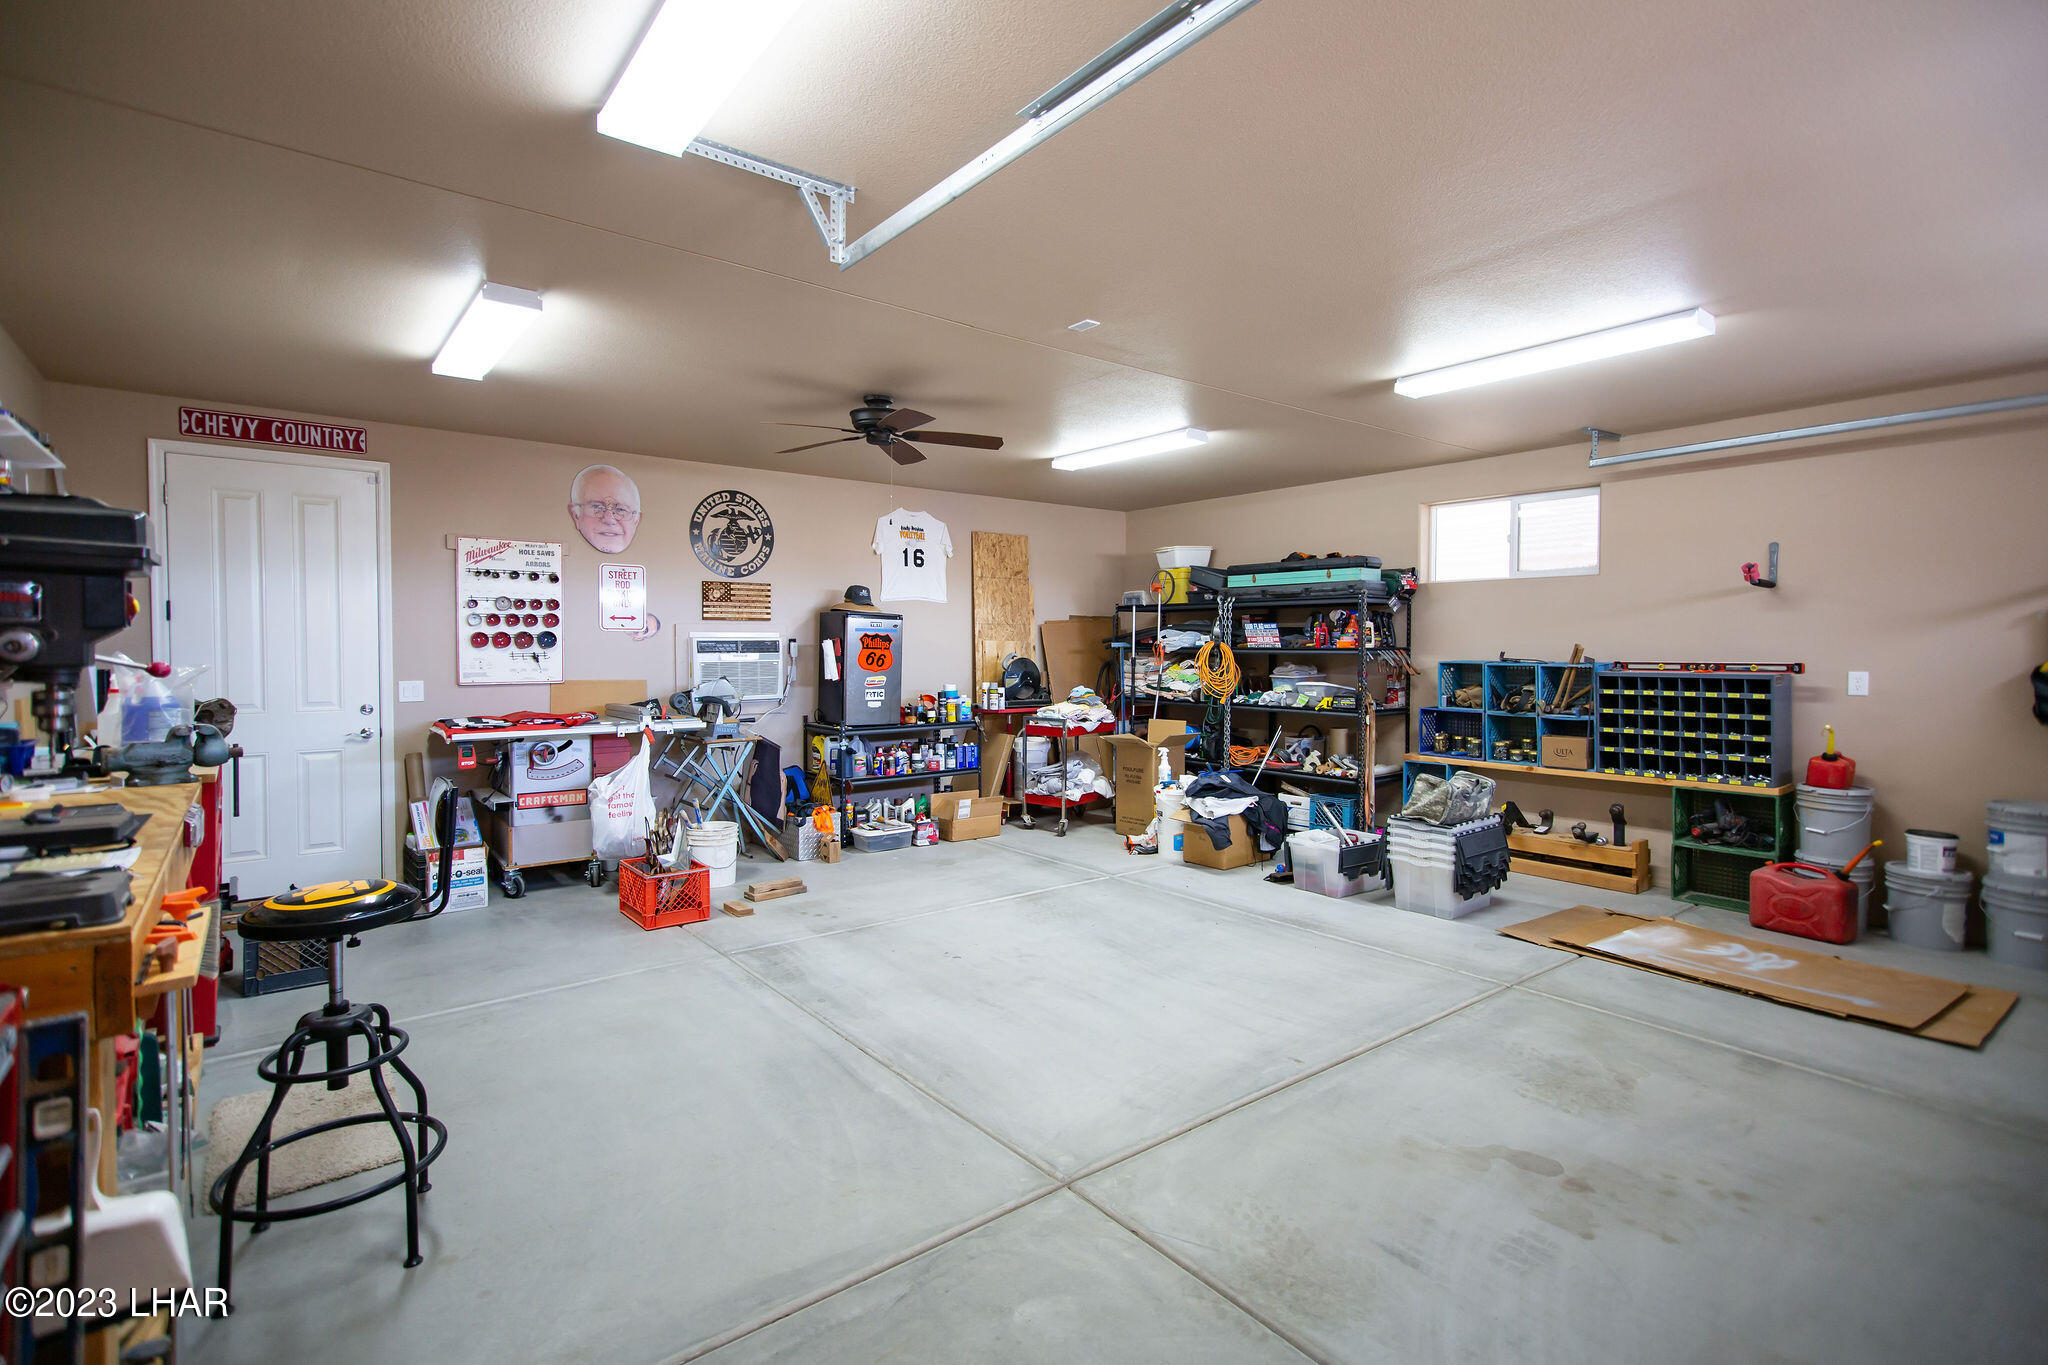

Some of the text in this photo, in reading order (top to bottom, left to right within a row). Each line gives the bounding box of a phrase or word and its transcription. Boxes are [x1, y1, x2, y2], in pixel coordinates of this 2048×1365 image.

[191, 412, 357, 450] CHEVY COUNTRY
[693, 492, 771, 528] UNITED STATES
[464, 541, 513, 563] Milwaukee
[694, 542, 771, 577] MARINE CORPS
[902, 547, 925, 568] 16
[608, 570, 637, 580] STREET
[615, 580, 631, 589] ROD
[862, 636, 890, 651] Phillips
[865, 652, 887, 667] 66
[1555, 748, 1574, 756] ULTA
[518, 792, 585, 806] CRAFTSMAN
